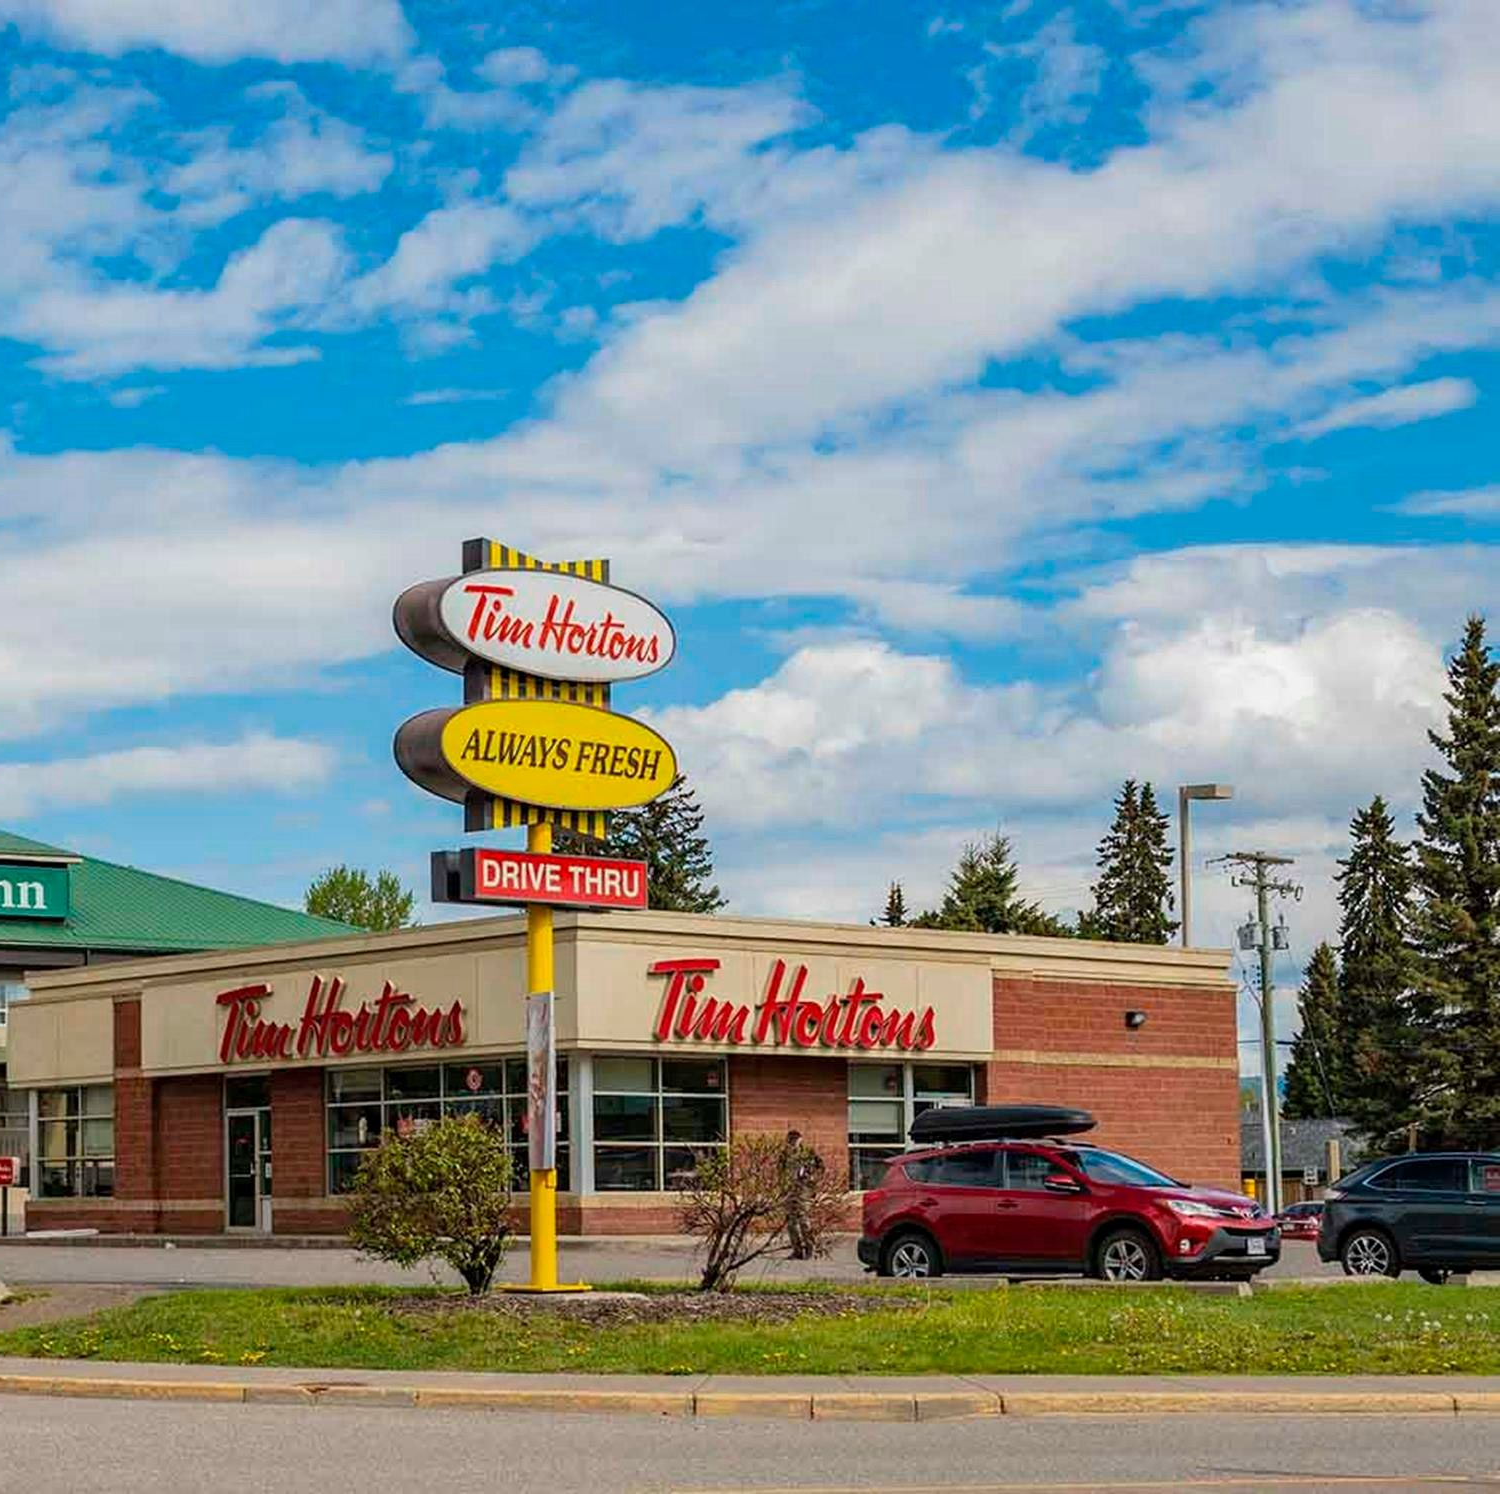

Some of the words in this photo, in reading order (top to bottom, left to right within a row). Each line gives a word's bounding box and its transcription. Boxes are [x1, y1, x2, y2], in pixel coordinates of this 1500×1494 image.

[463, 584, 534, 650] Tim
[537, 594, 659, 665] Hortons
[461, 728, 571, 769] ALWAYS
[574, 740, 662, 781] FRESH
[482, 859, 561, 893] DRIVE
[568, 865, 639, 898] THRU
[216, 984, 294, 1064] Tim
[296, 974, 466, 1056] Hortons
[649, 958, 750, 1044] Tim
[753, 958, 936, 1050] Hortons
